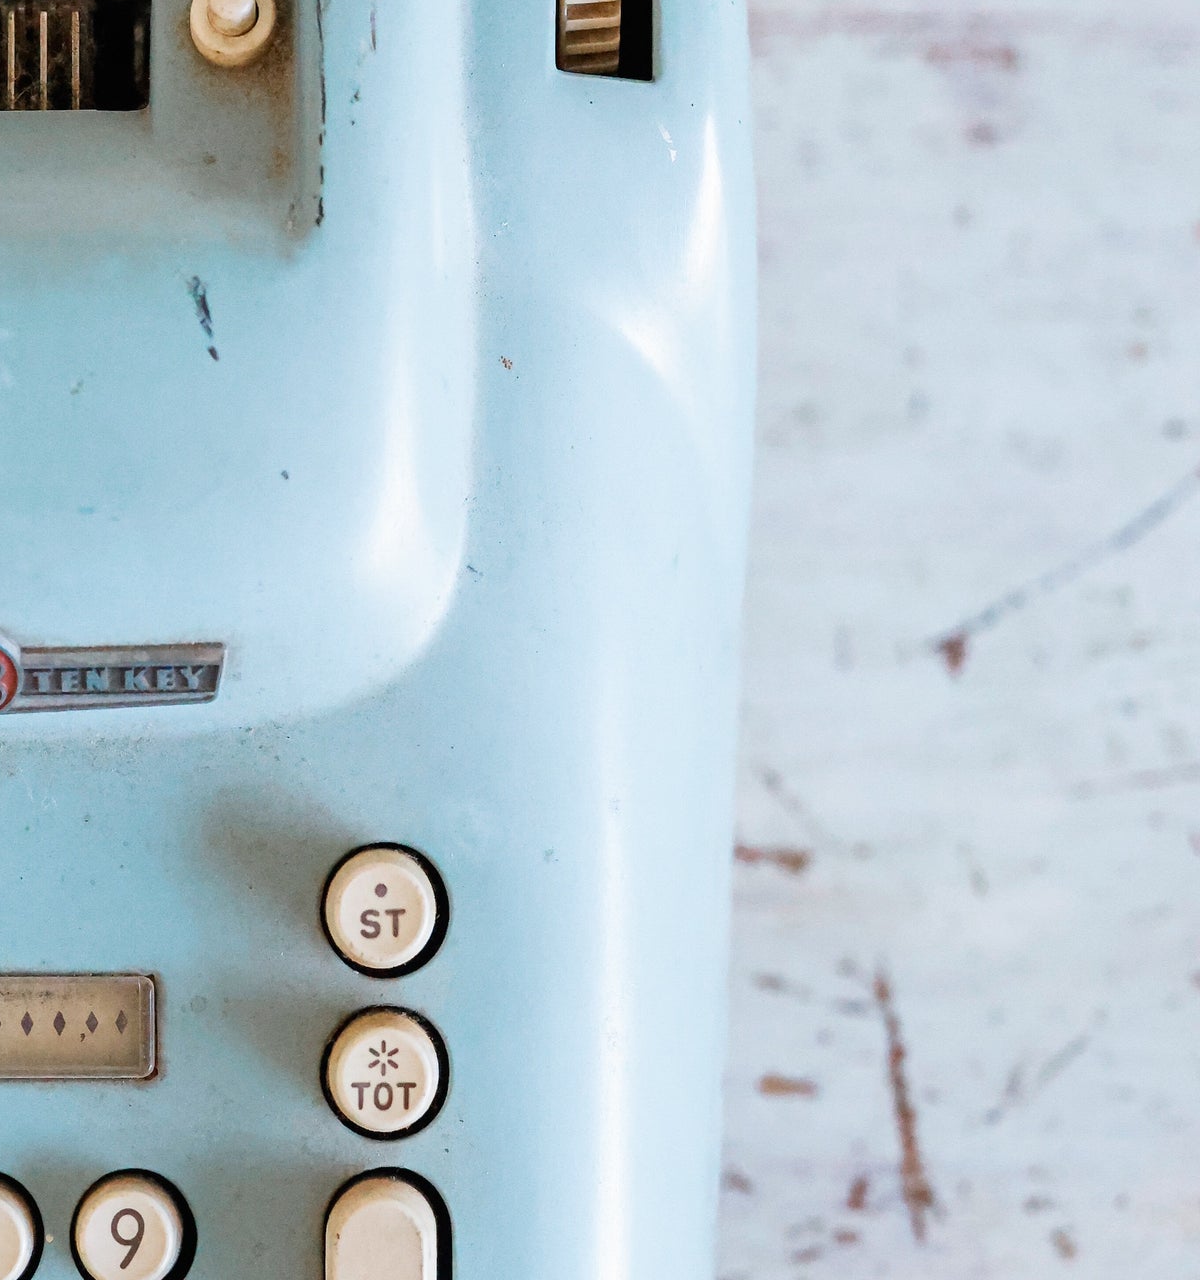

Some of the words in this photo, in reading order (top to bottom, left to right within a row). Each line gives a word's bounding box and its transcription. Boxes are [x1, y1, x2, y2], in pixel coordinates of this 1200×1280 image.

[32, 668, 110, 694] TEN
[123, 667, 206, 692] KEY
[360, 909, 406, 939] ST
[351, 1082, 416, 1111] TOT
[110, 1207, 145, 1270] 9
